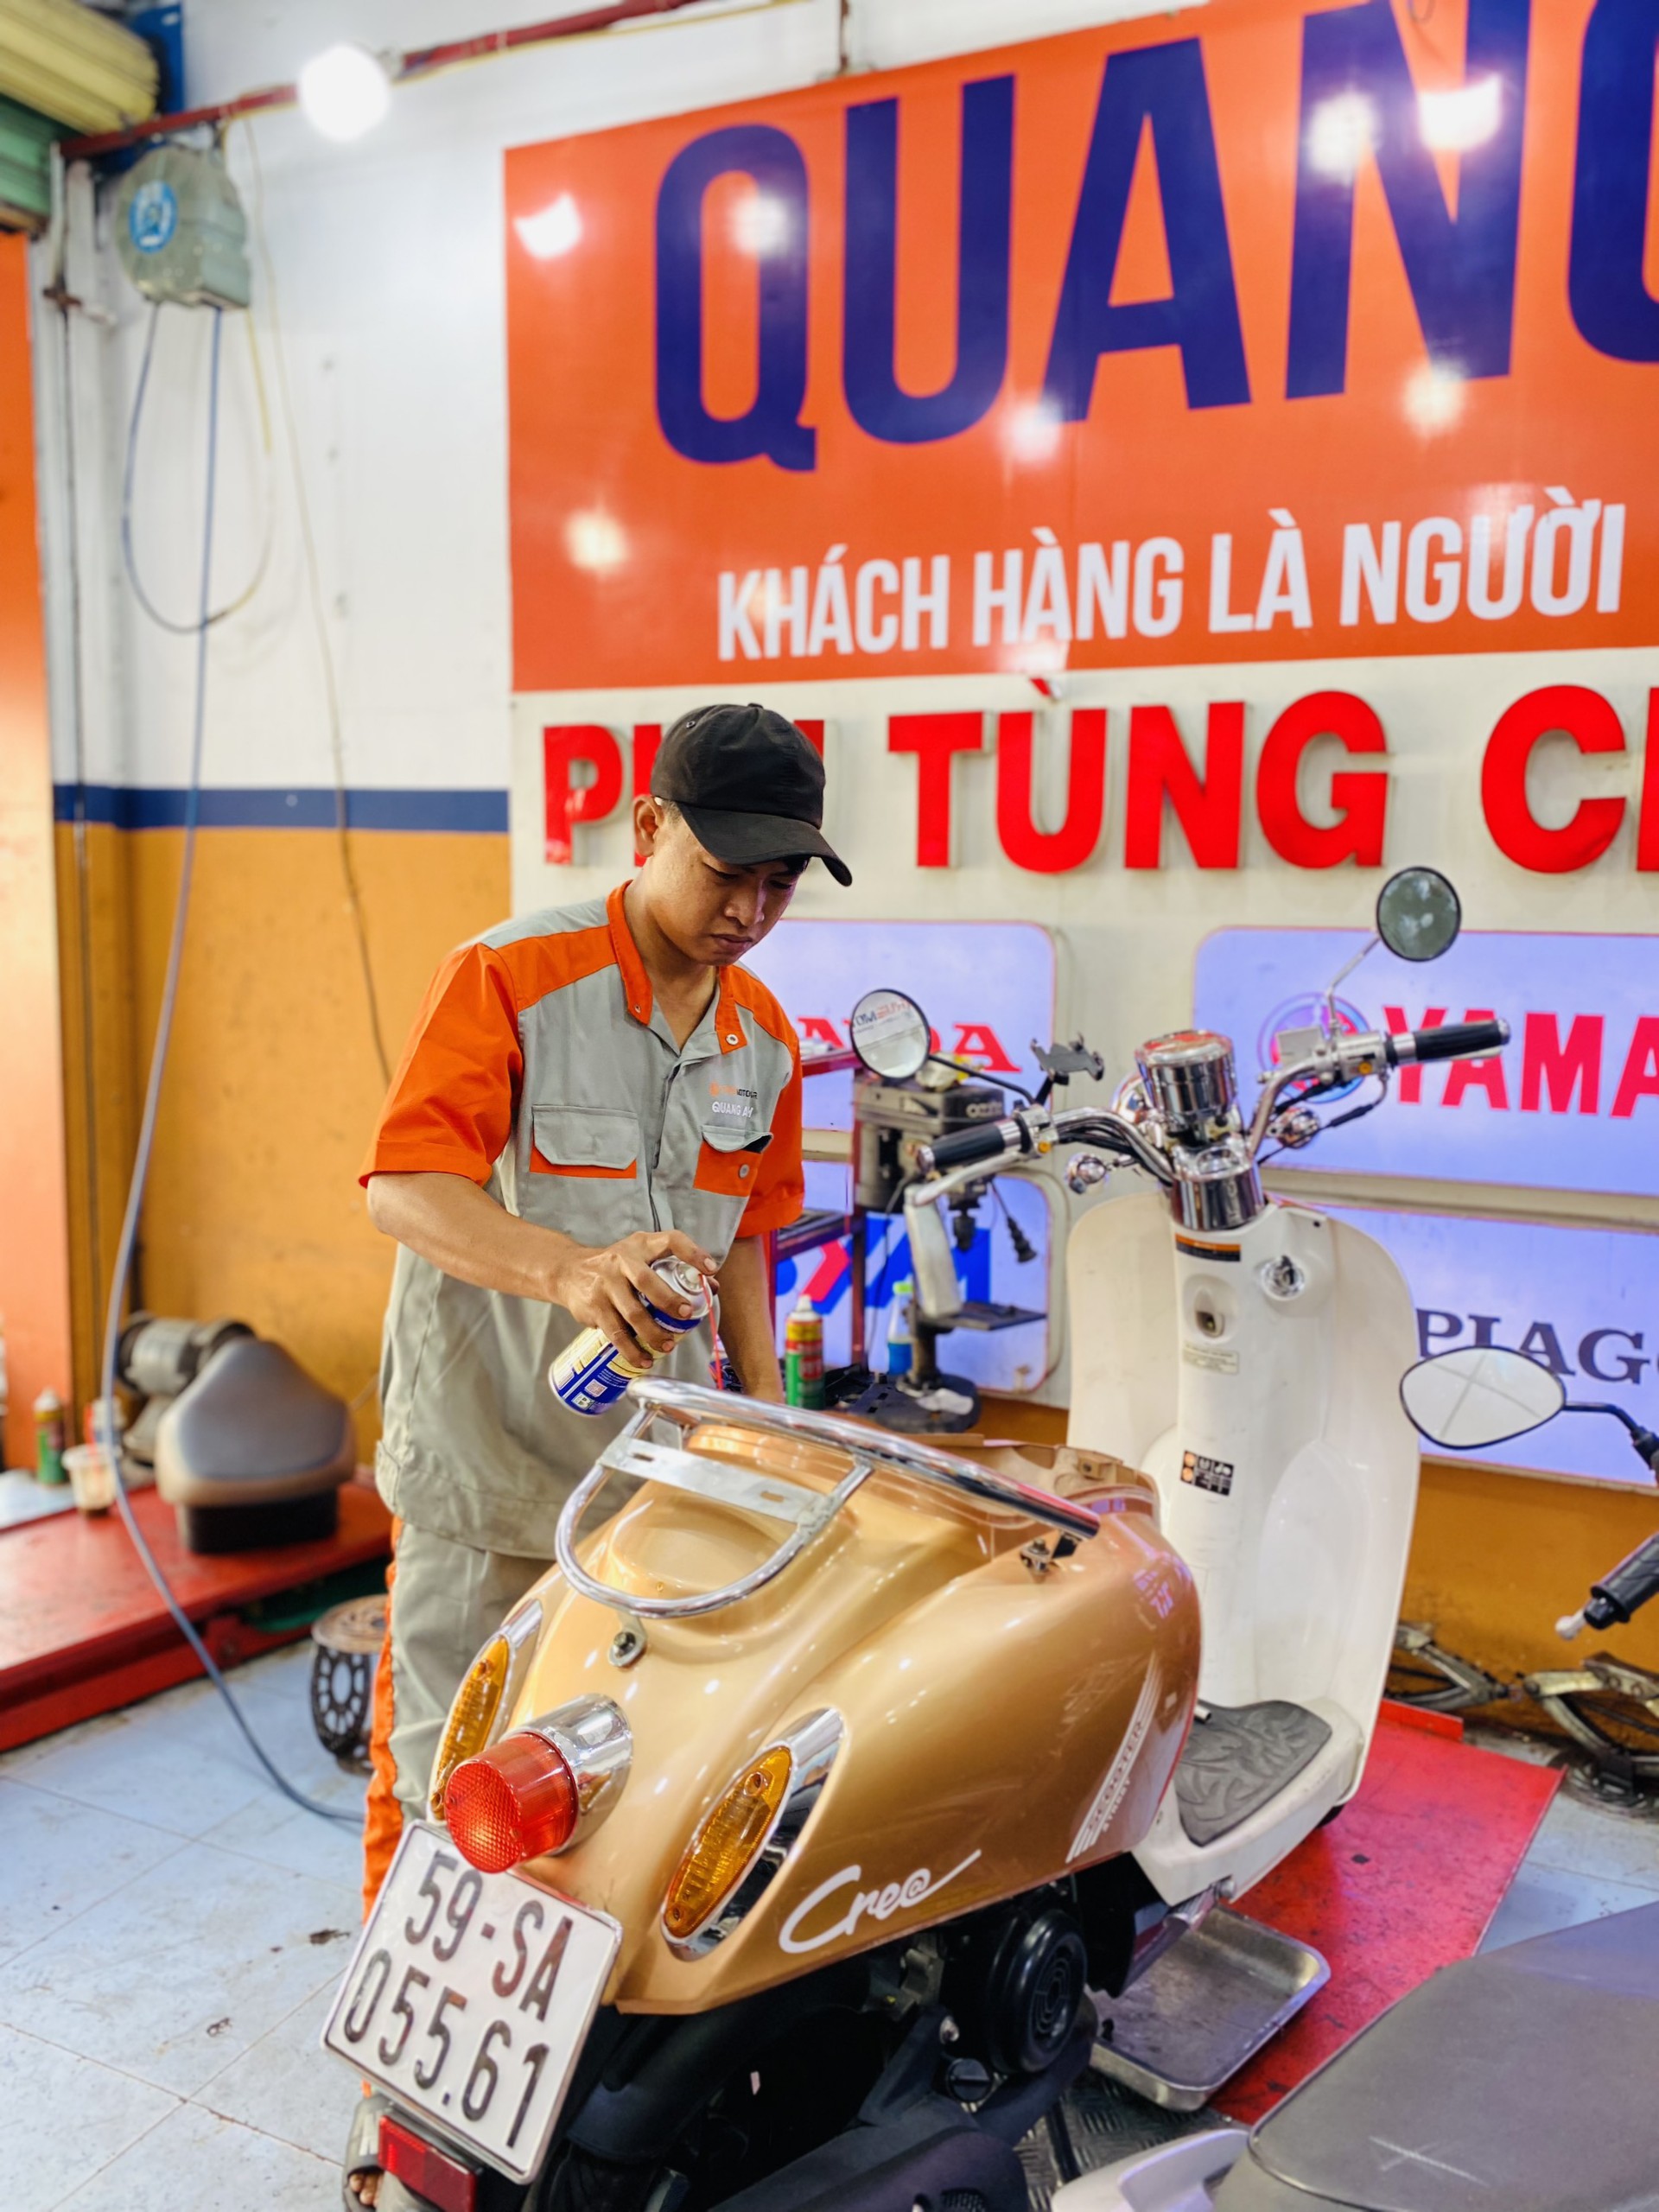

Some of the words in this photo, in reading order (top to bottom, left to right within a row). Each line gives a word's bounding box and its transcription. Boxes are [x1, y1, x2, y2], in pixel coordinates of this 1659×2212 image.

[718, 543, 950, 661] KHÁCH
[972, 526, 1185, 647] HÀNG
[1209, 508, 1313, 632] LÀ
[1338, 486, 1626, 627] NGƯỜI
[887, 677, 1389, 875] TÙNG
[1480, 683, 1659, 874] C
[1415, 1307, 1659, 1385] PIAG
[404, 1849, 574, 2023] 59-SA
[343, 1948, 550, 2149] 055.61
